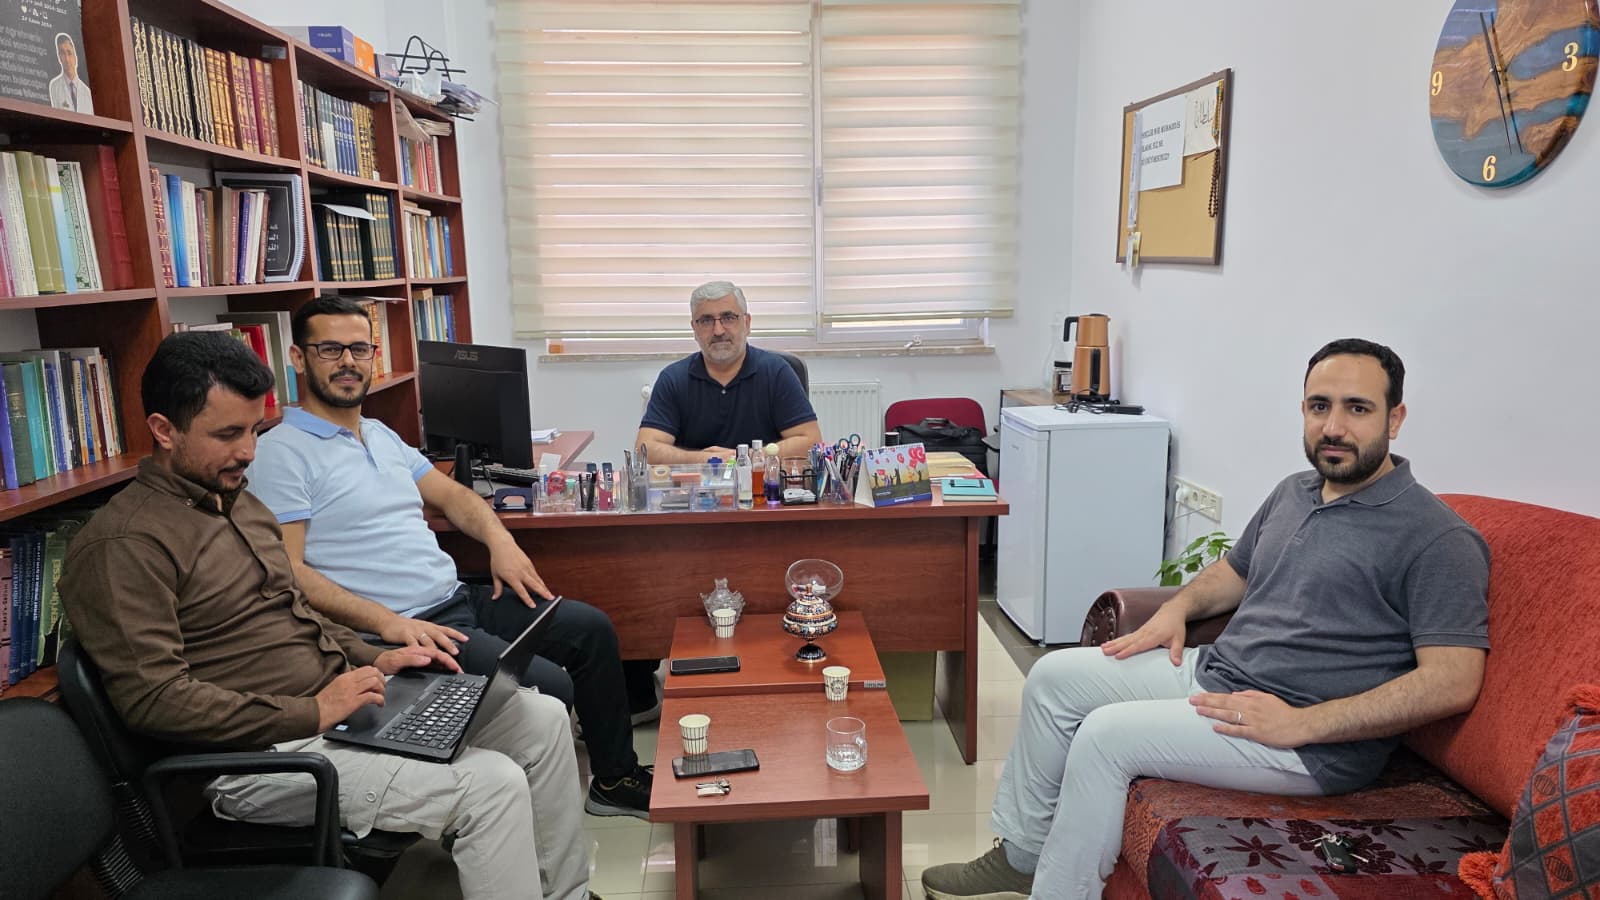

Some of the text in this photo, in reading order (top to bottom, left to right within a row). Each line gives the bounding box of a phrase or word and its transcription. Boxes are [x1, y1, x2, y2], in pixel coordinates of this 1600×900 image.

[1562, 42, 1579, 72] 3
[1431, 71, 1443, 96] 9
[1482, 155, 1497, 182] 6
[454, 350, 479, 361] ASUS
